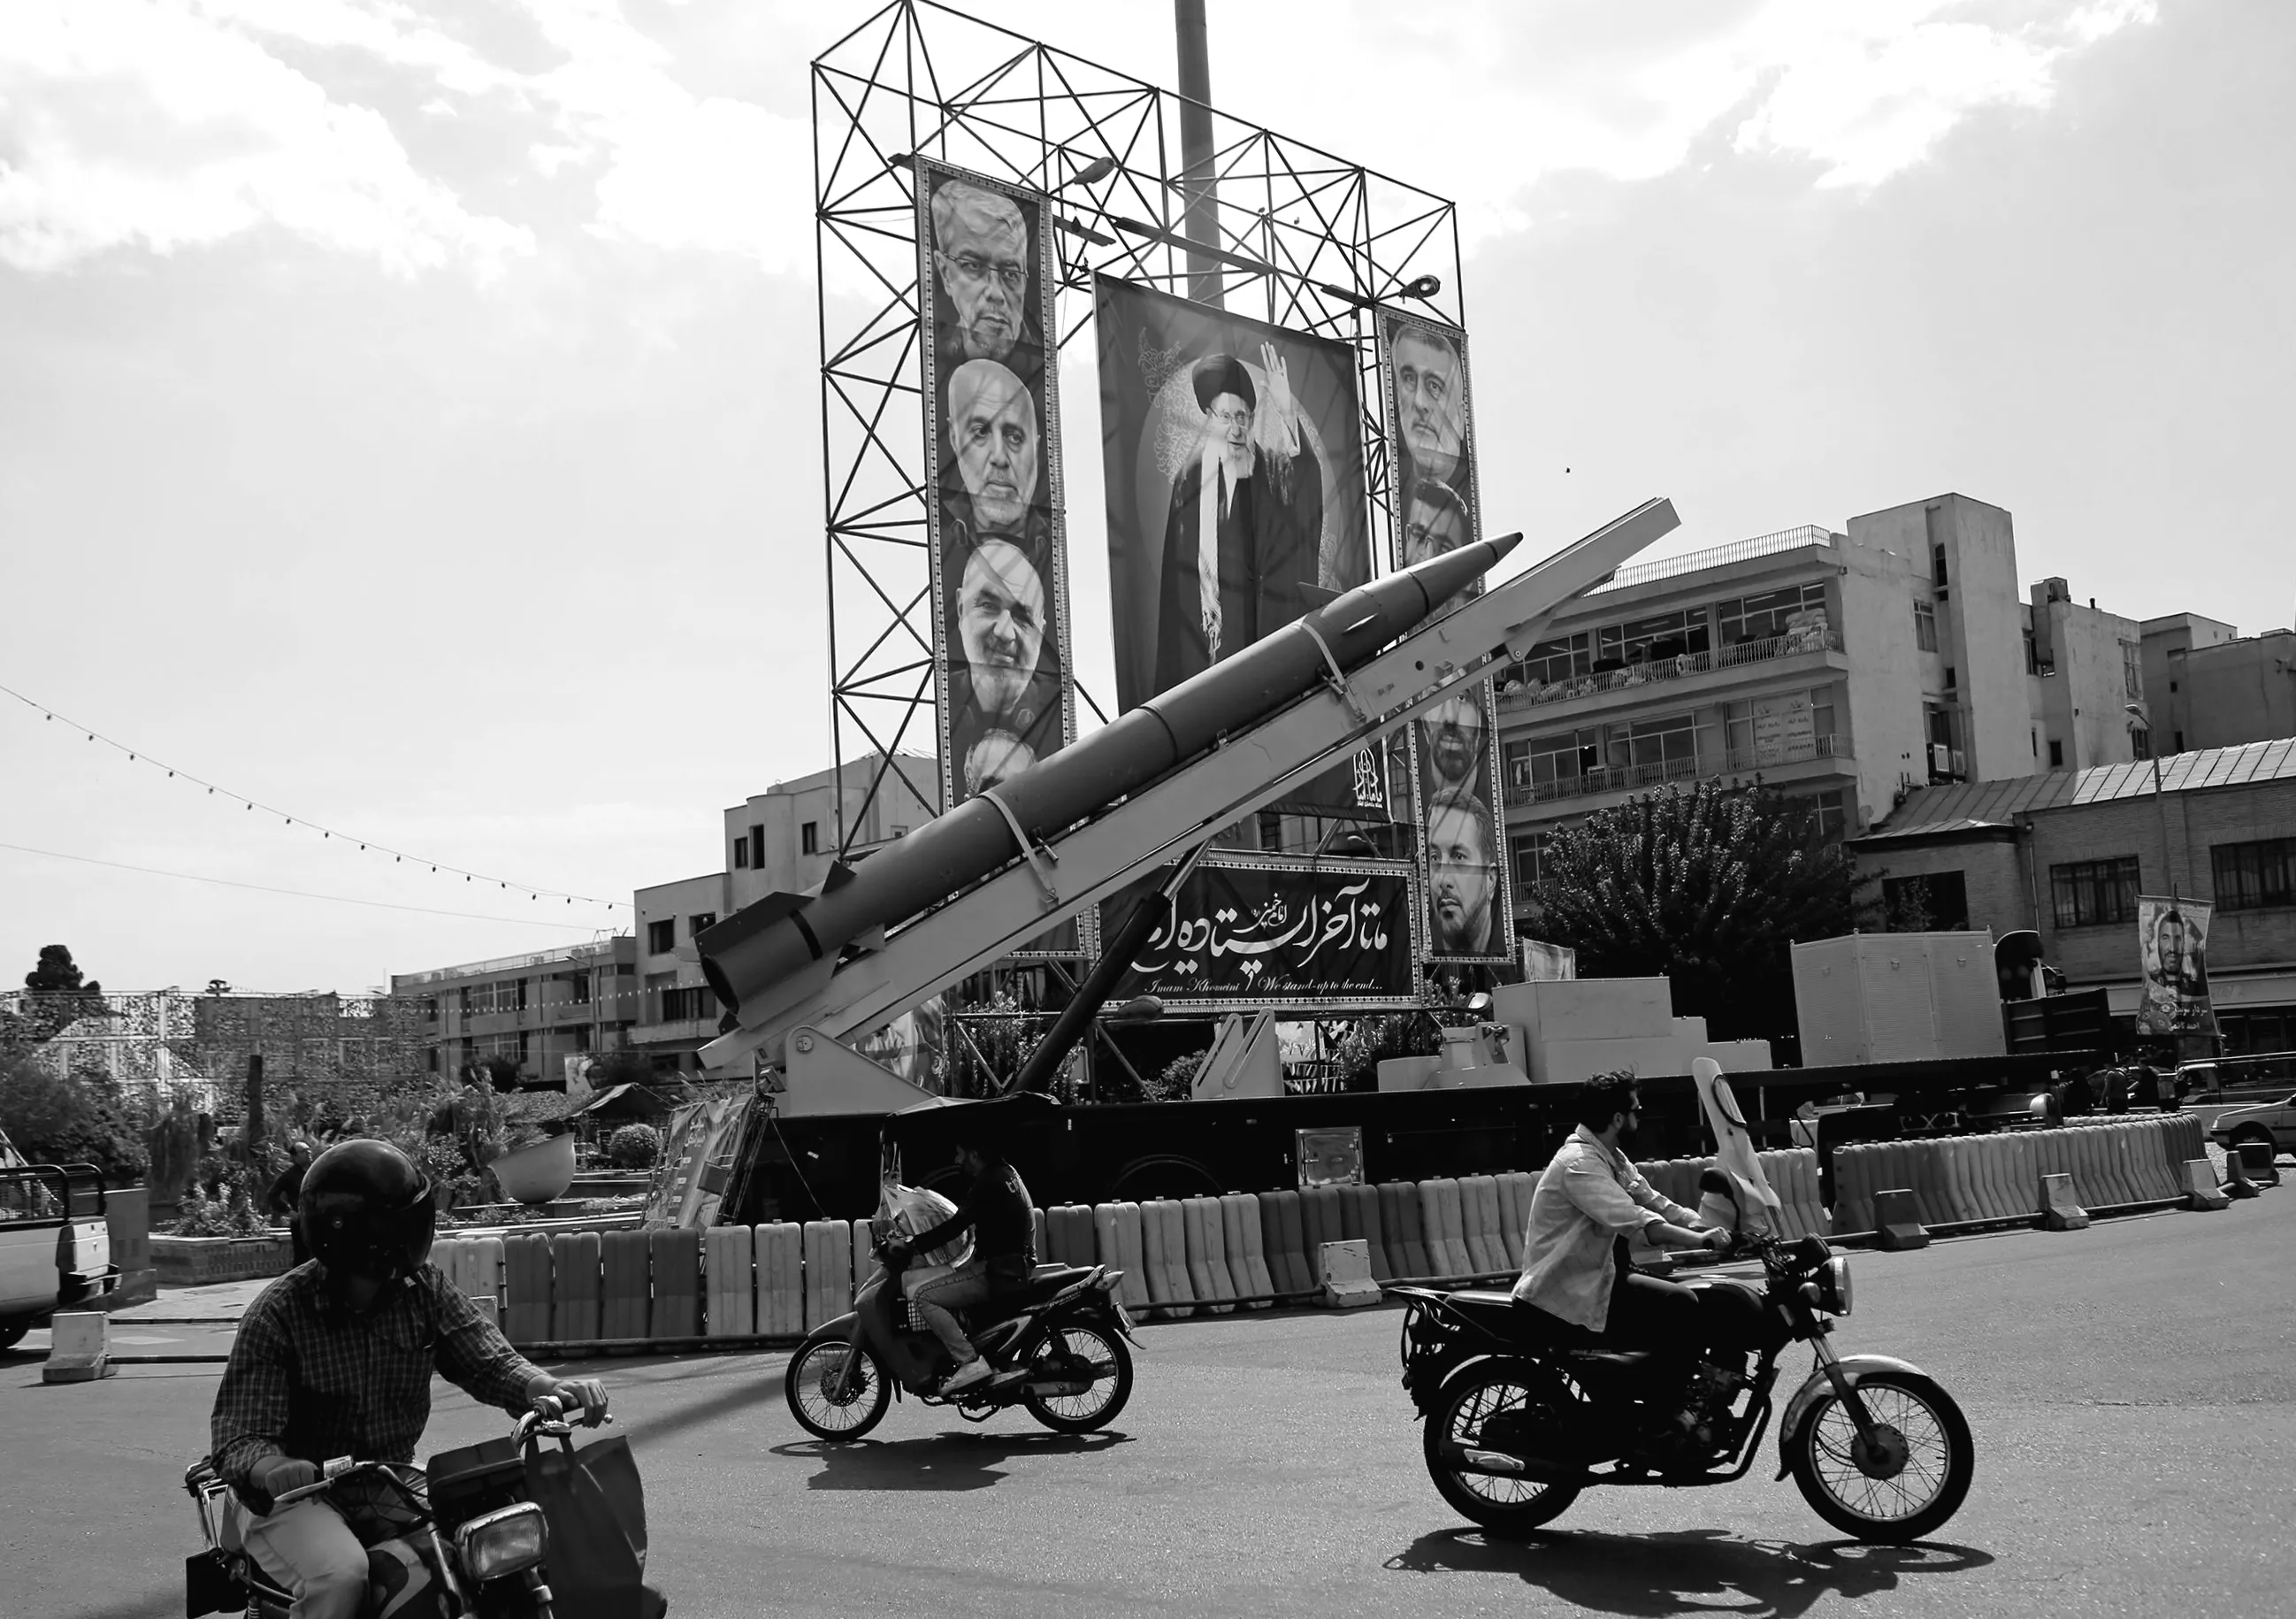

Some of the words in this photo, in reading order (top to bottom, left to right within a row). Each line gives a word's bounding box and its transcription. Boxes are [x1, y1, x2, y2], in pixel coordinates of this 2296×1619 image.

[1297, 877, 1370, 968] آخر
[1359, 902, 1381, 950] تا
[1374, 921, 1388, 950] ما
[1144, 978, 1183, 993] Imam
[1186, 977, 1240, 993] Khomeini
[1257, 973, 1290, 992] We
[1329, 980, 1339, 990] to
[1341, 978, 1354, 990] the
